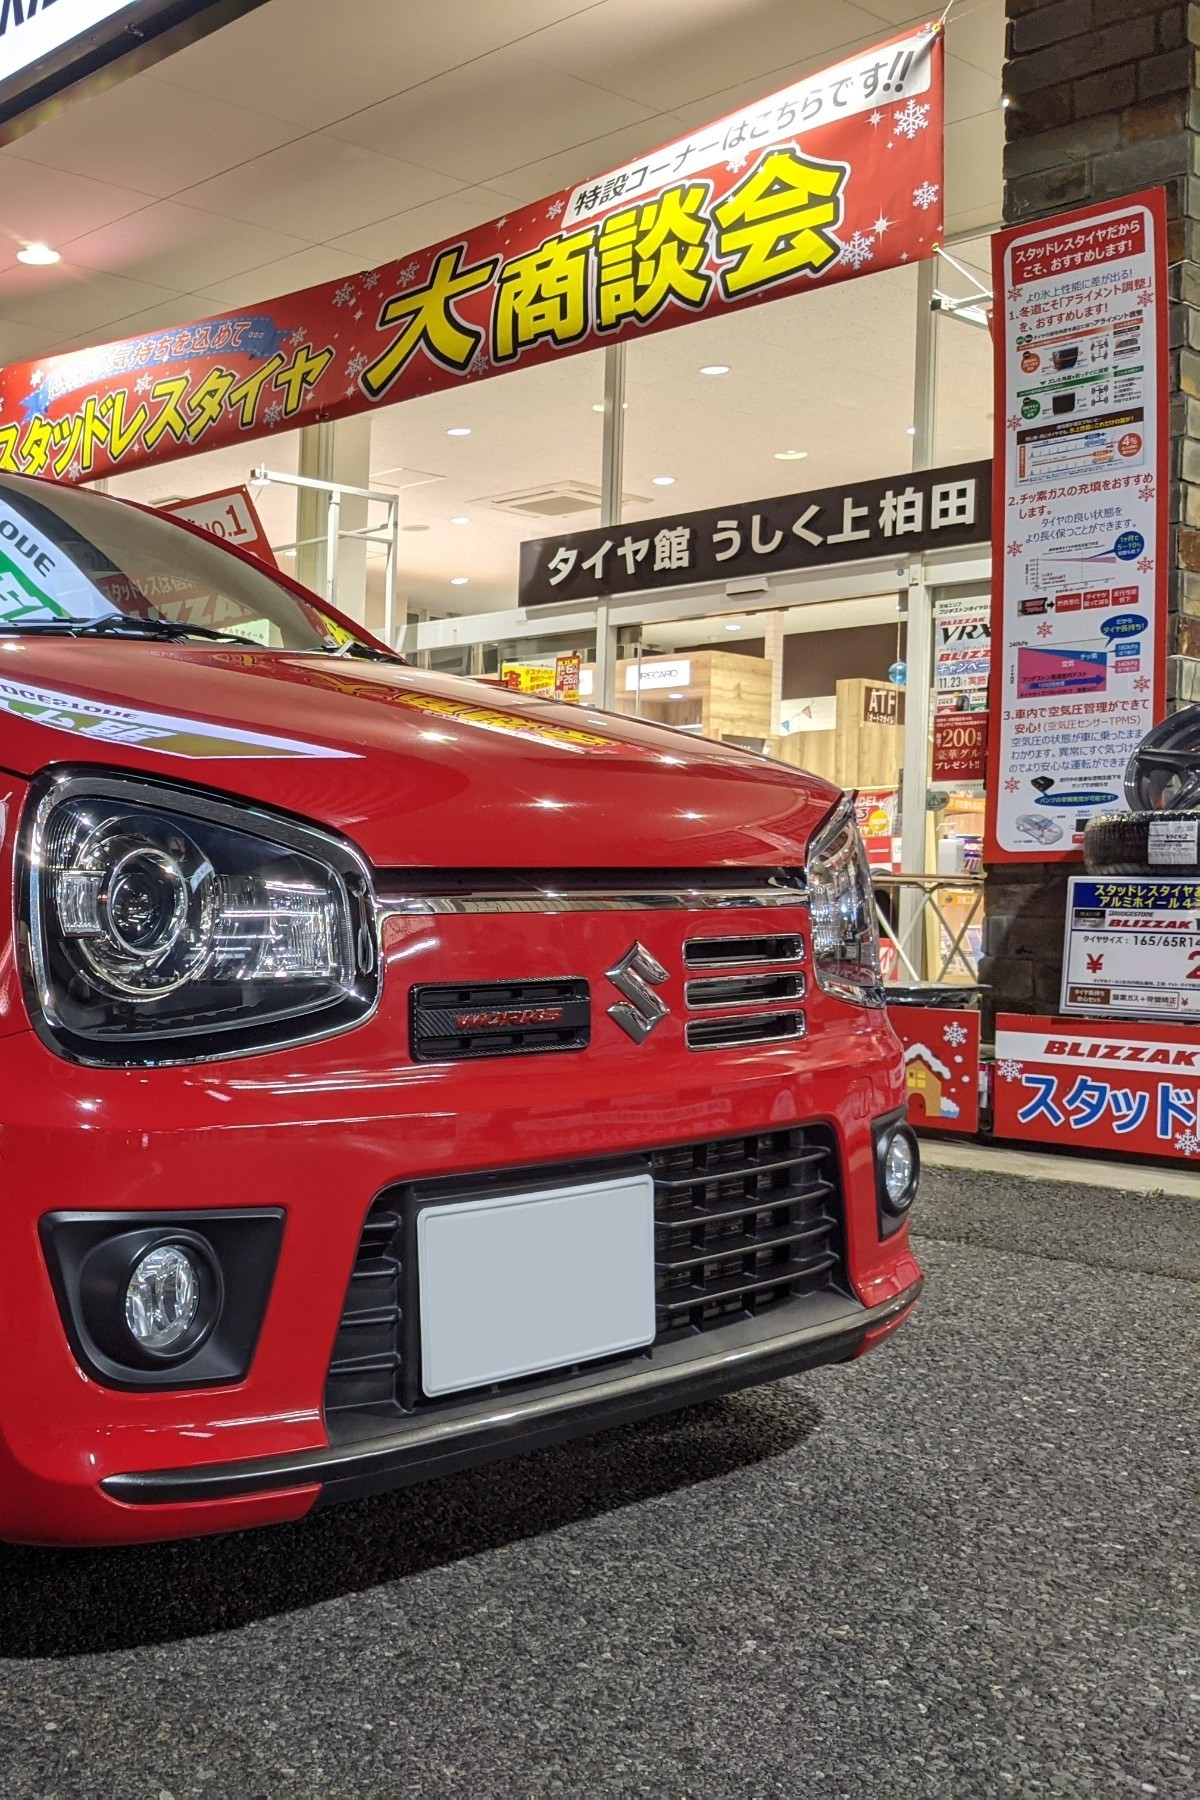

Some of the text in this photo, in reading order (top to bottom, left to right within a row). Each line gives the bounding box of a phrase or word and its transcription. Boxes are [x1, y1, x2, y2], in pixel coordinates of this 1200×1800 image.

[1015, 220, 1140, 264] スタッドレスタイヤだから
[1023, 240, 1132, 278] こそ、おすすめします!
[360, 148, 849, 398] 大商談会
[1026, 268, 1133, 304] より氷上性能に差が出る!
[1019, 302, 1108, 333] を、おすすめします!
[1019, 504, 1052, 520] します。
[1041, 506, 1123, 529] タイヤの良い状態を
[547, 478, 977, 587] タイヤ館 うしく上柏田
[1025, 518, 1137, 544] より長く保つことができます。
[940, 616, 986, 627] BLIZZAK
[1103, 623, 1145, 634] タイヤ長持ち!
[641, 669, 678, 681] RECARO
[868, 688, 896, 715] ATF
[1003, 698, 1150, 721] 3.車内で空気圧管理ができて
[942, 727, 977, 748] 200
[1011, 729, 1143, 748] 空気圧の状態が車に乗ったまま
[1108, 909, 1155, 918] BRIDGESTONE
[1108, 918, 1194, 930] BLIZZAK
[1086, 952, 1105, 974] ¥
[455, 1008, 563, 1029] WORKS
[1043, 1039, 1199, 1067] BLIZZAK
[1017, 1072, 1200, 1140] スタッド
